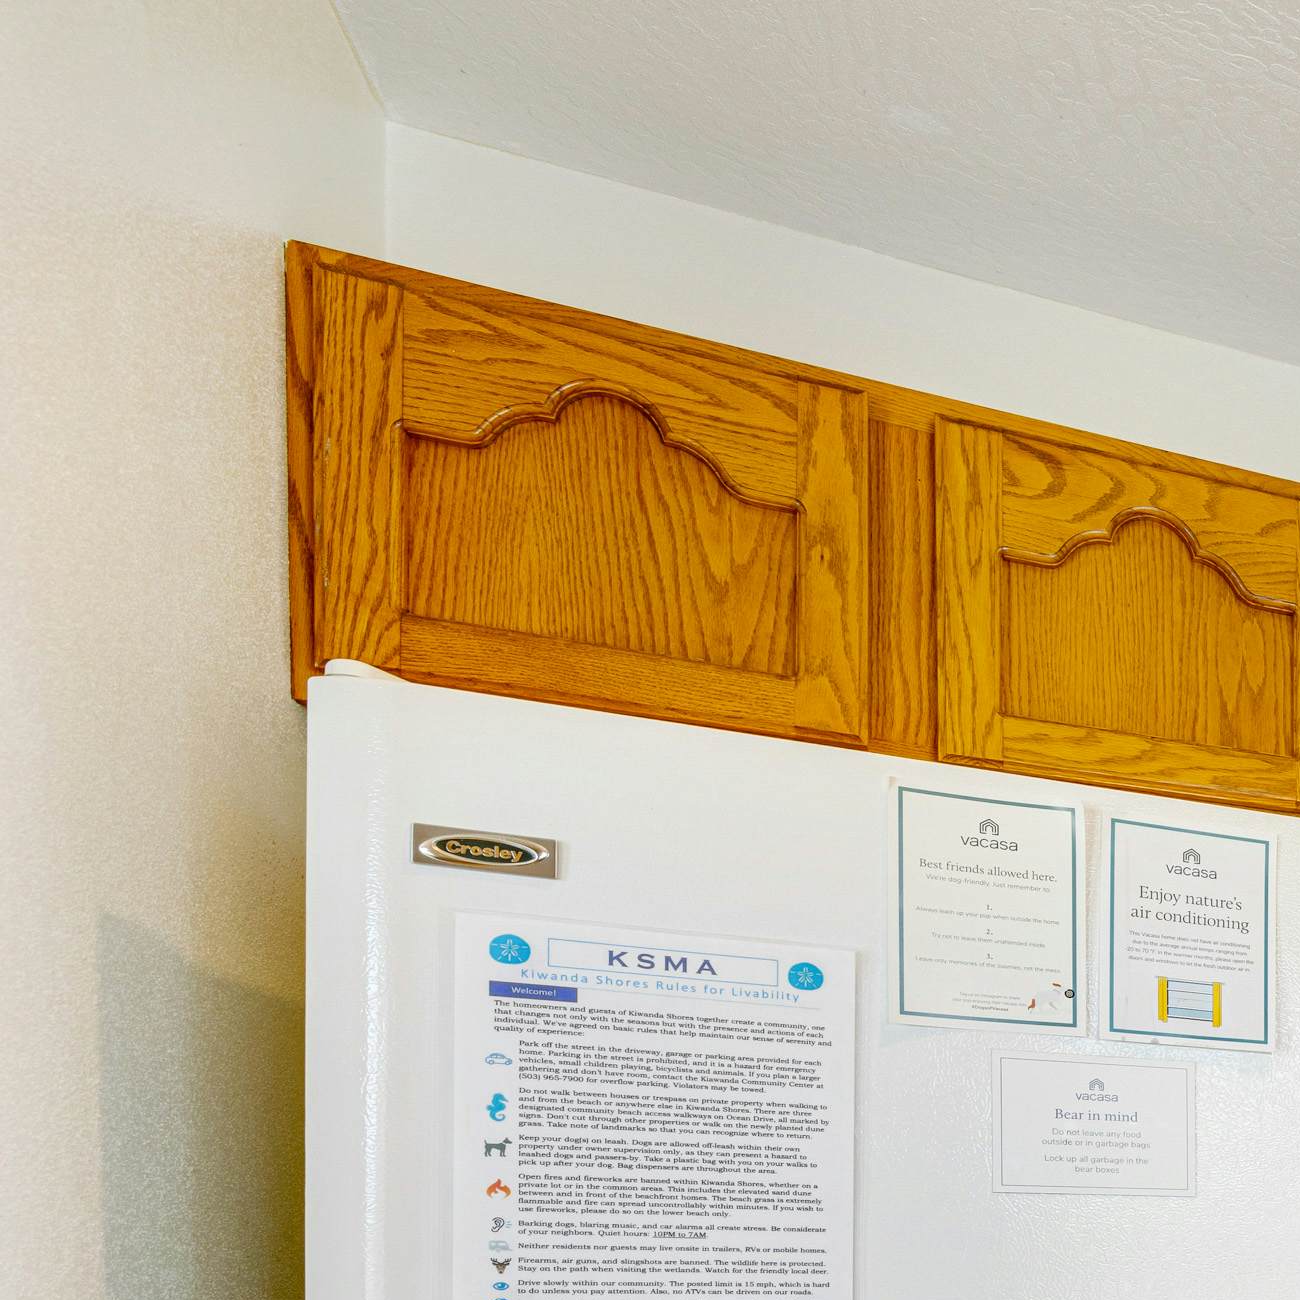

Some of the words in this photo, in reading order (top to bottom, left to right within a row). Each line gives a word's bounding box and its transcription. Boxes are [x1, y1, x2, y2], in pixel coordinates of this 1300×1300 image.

[961, 835, 1018, 851] vacasa
[445, 839, 524, 863] Crosley
[919, 858, 943, 870] Best
[946, 860, 985, 875] friends
[987, 865, 1029, 880] allowed
[1032, 870, 1058, 883] here.
[1166, 864, 1217, 879] vacasa
[1139, 885, 1181, 906] Enjoy
[1185, 895, 1242, 911] nature's
[1130, 906, 1152, 919] air
[1156, 910, 1250, 934] conditioning
[607, 950, 718, 976] KSMA
[511, 986, 557, 997] Welcome!
[520, 968, 589, 984] Kiwanda
[596, 975, 649, 989] Shores
[655, 979, 697, 994] Rules
[703, 983, 726, 997] for
[731, 986, 800, 1004] Livability
[518, 1072, 540, 1080] (503)
[543, 1074, 584, 1082] 965-7900
[636, 1080, 670, 1089] parking.
[673, 1082, 708, 1090] Violators
[1075, 1092, 1118, 1102] vacasa
[1055, 1108, 1084, 1120] Bear
[1088, 1110, 1100, 1120] in
[1105, 1111, 1138, 1123] mind
[1052, 1127, 1064, 1136] Do
[1082, 1129, 1104, 1137] leave
[1106, 1131, 1120, 1139] any
[1123, 1131, 1141, 1139] food
[518, 1134, 540, 1142] Keep
[702, 1142, 735, 1150] off-leash
[1041, 1138, 1072, 1146] outside
[1095, 1140, 1129, 1149] garbage
[1044, 1154, 1063, 1162] Lock
[1091, 1156, 1124, 1165] garbage
[518, 1220, 552, 1228] Barking
[555, 1221, 576, 1229] dogs,
[610, 1244, 637, 1252] guests
